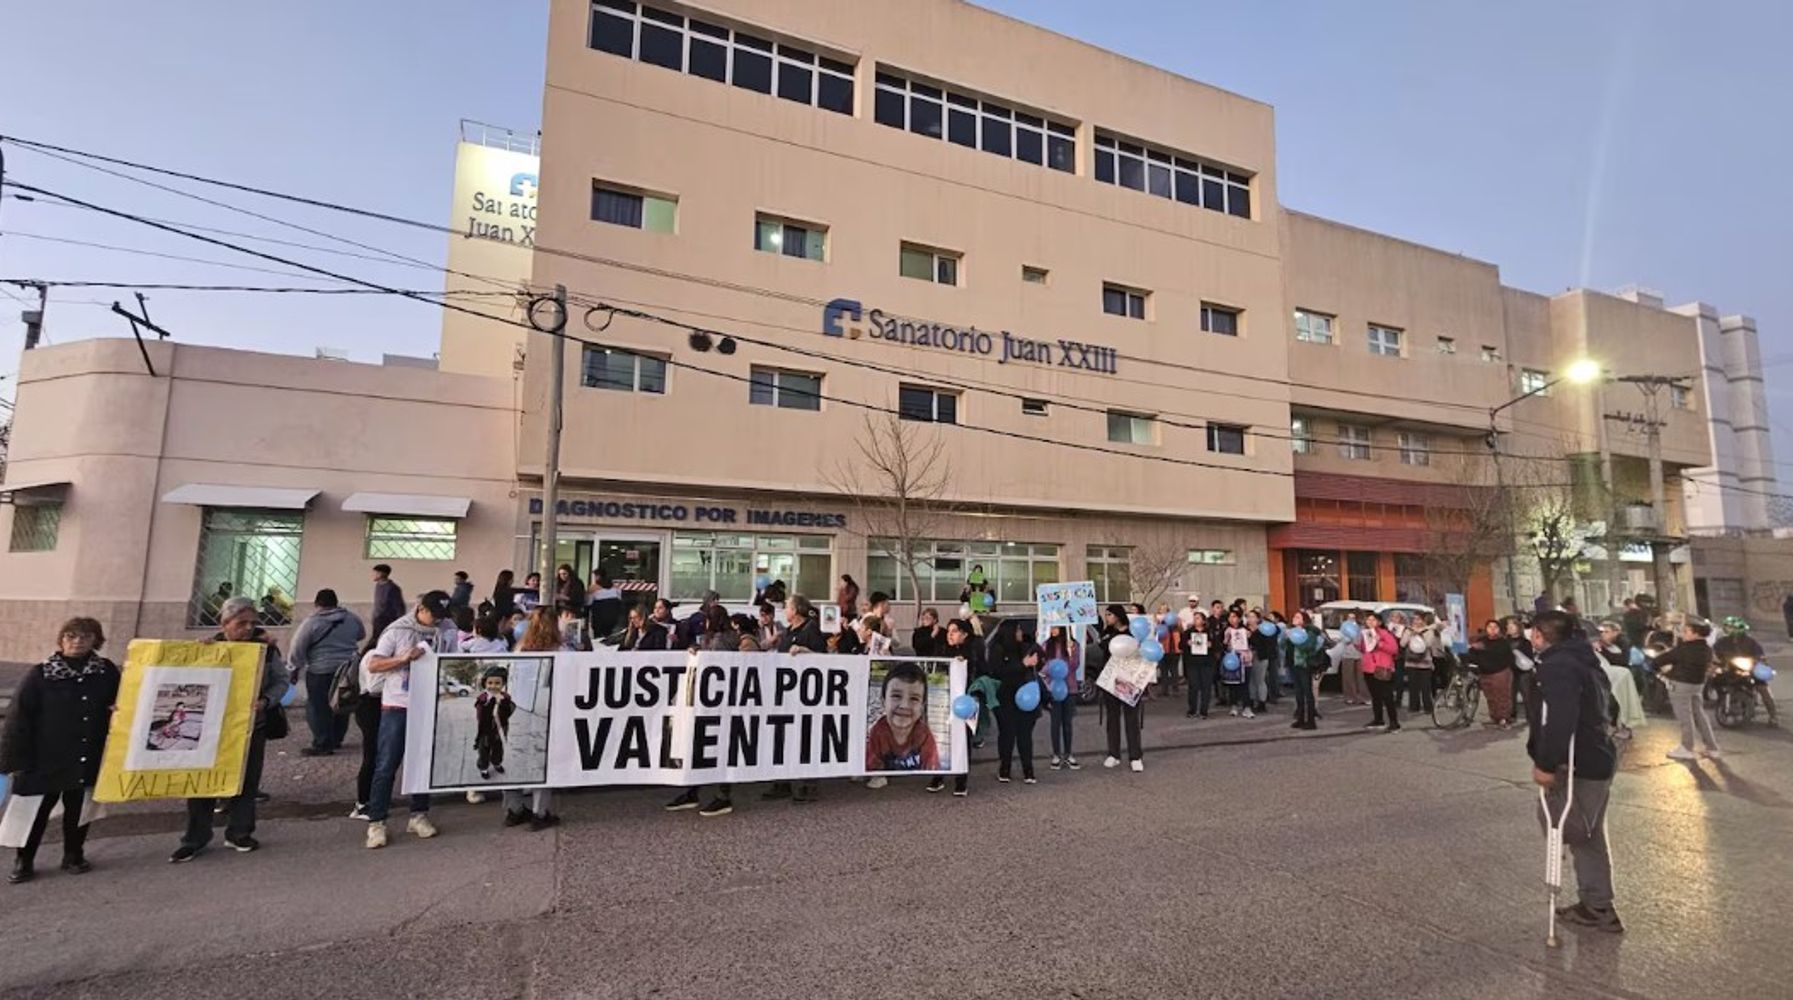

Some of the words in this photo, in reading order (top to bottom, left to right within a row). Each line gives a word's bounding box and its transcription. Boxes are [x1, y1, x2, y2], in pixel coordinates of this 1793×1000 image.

[464, 217, 513, 242] Juan
[869, 308, 992, 355] Sanatorio
[997, 331, 1052, 364] Juan
[1057, 339, 1118, 374] XXIII
[529, 498, 688, 521] DAGNOSTICO
[694, 506, 737, 524] POR
[746, 509, 847, 527] IMAGENES
[574, 665, 763, 710] JUSTICIA
[774, 667, 849, 707] POR
[574, 714, 849, 770] VALENTIN
